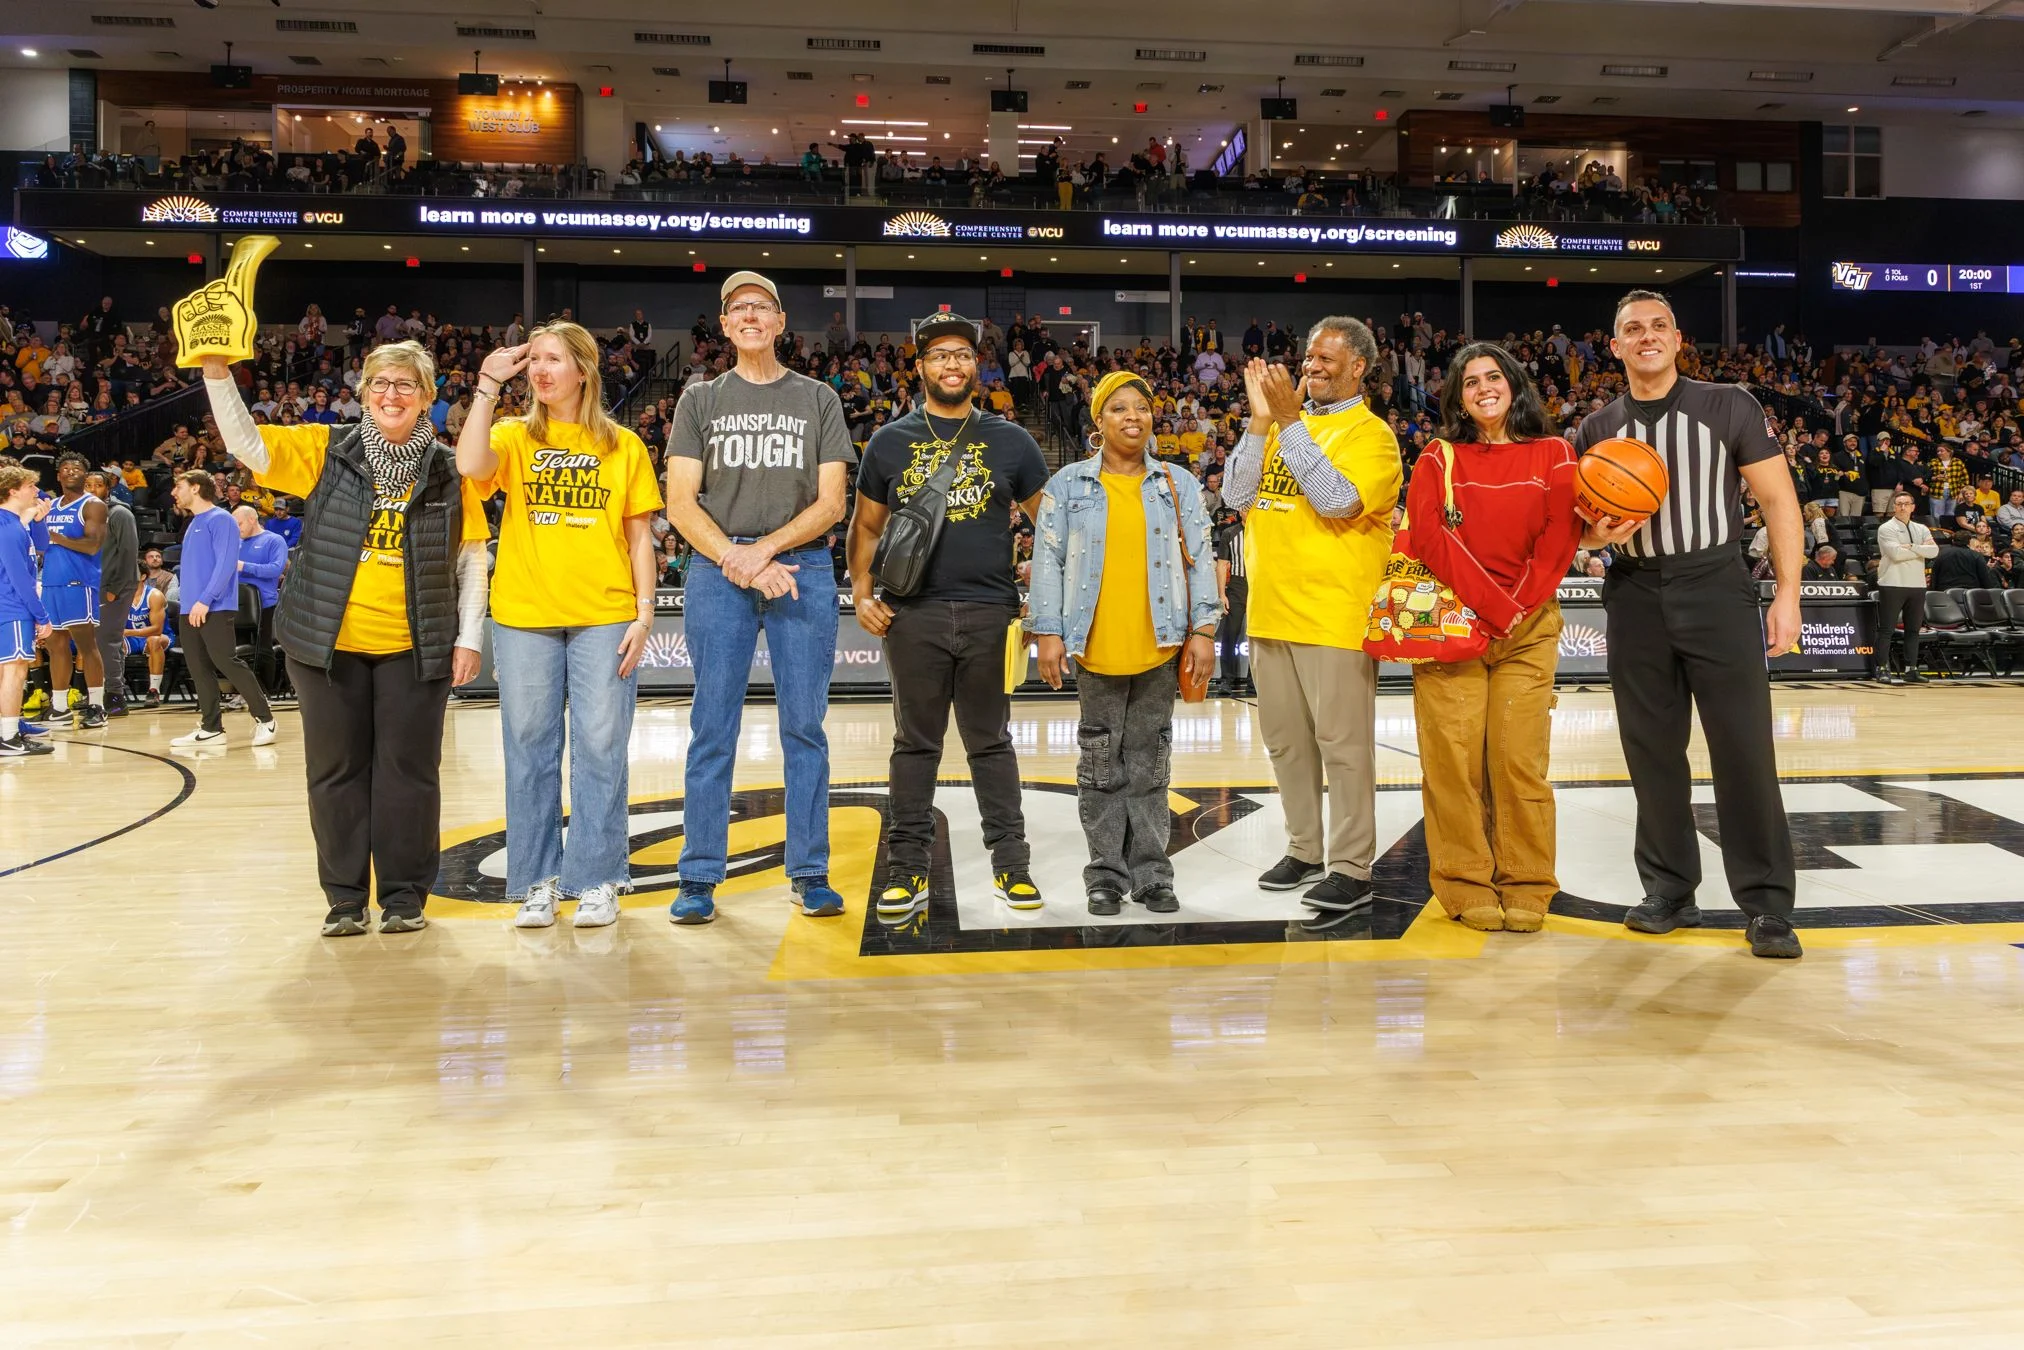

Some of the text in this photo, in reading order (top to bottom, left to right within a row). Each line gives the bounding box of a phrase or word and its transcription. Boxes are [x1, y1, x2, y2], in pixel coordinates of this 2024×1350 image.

[277, 84, 430, 97] PROSPERITY HOME MORTGAGE
[474, 110, 518, 121] TOMMY
[468, 121, 540, 133] WEST CLUB
[142, 206, 220, 222] MASSEY
[223, 210, 298, 218] COMPREHENSIVE
[315, 213, 344, 224] VCU
[420, 206, 811, 234] learn more vcumassey.org/screening
[883, 220, 953, 236] MASSEY
[1037, 227, 1064, 238] VCU
[1103, 219, 1457, 246] learn more vcumassey.org/screening
[1495, 234, 1560, 249] MASSEY
[1561, 237, 1623, 246] COMPREHENSIVE
[1636, 241, 1660, 250] VCU
[1835, 263, 1872, 291] VCU
[1927, 270, 1938, 286] 0
[1959, 269, 1992, 280] 20:00
[191, 323, 232, 333] MASSEY
[200, 337, 230, 346] VCU
[711, 413, 807, 436] TRANSPLANT
[709, 433, 804, 470] TOUGH
[531, 448, 601, 472] Team
[534, 468, 599, 487] RAM
[523, 483, 610, 510] NATION
[533, 510, 561, 525] VCU
[1556, 588, 1600, 598] NDA
[1801, 623, 1855, 634] Children's
[1802, 635, 1849, 648] Hospital
[845, 651, 880, 664] VCU
[1856, 647, 1874, 655] VCU
